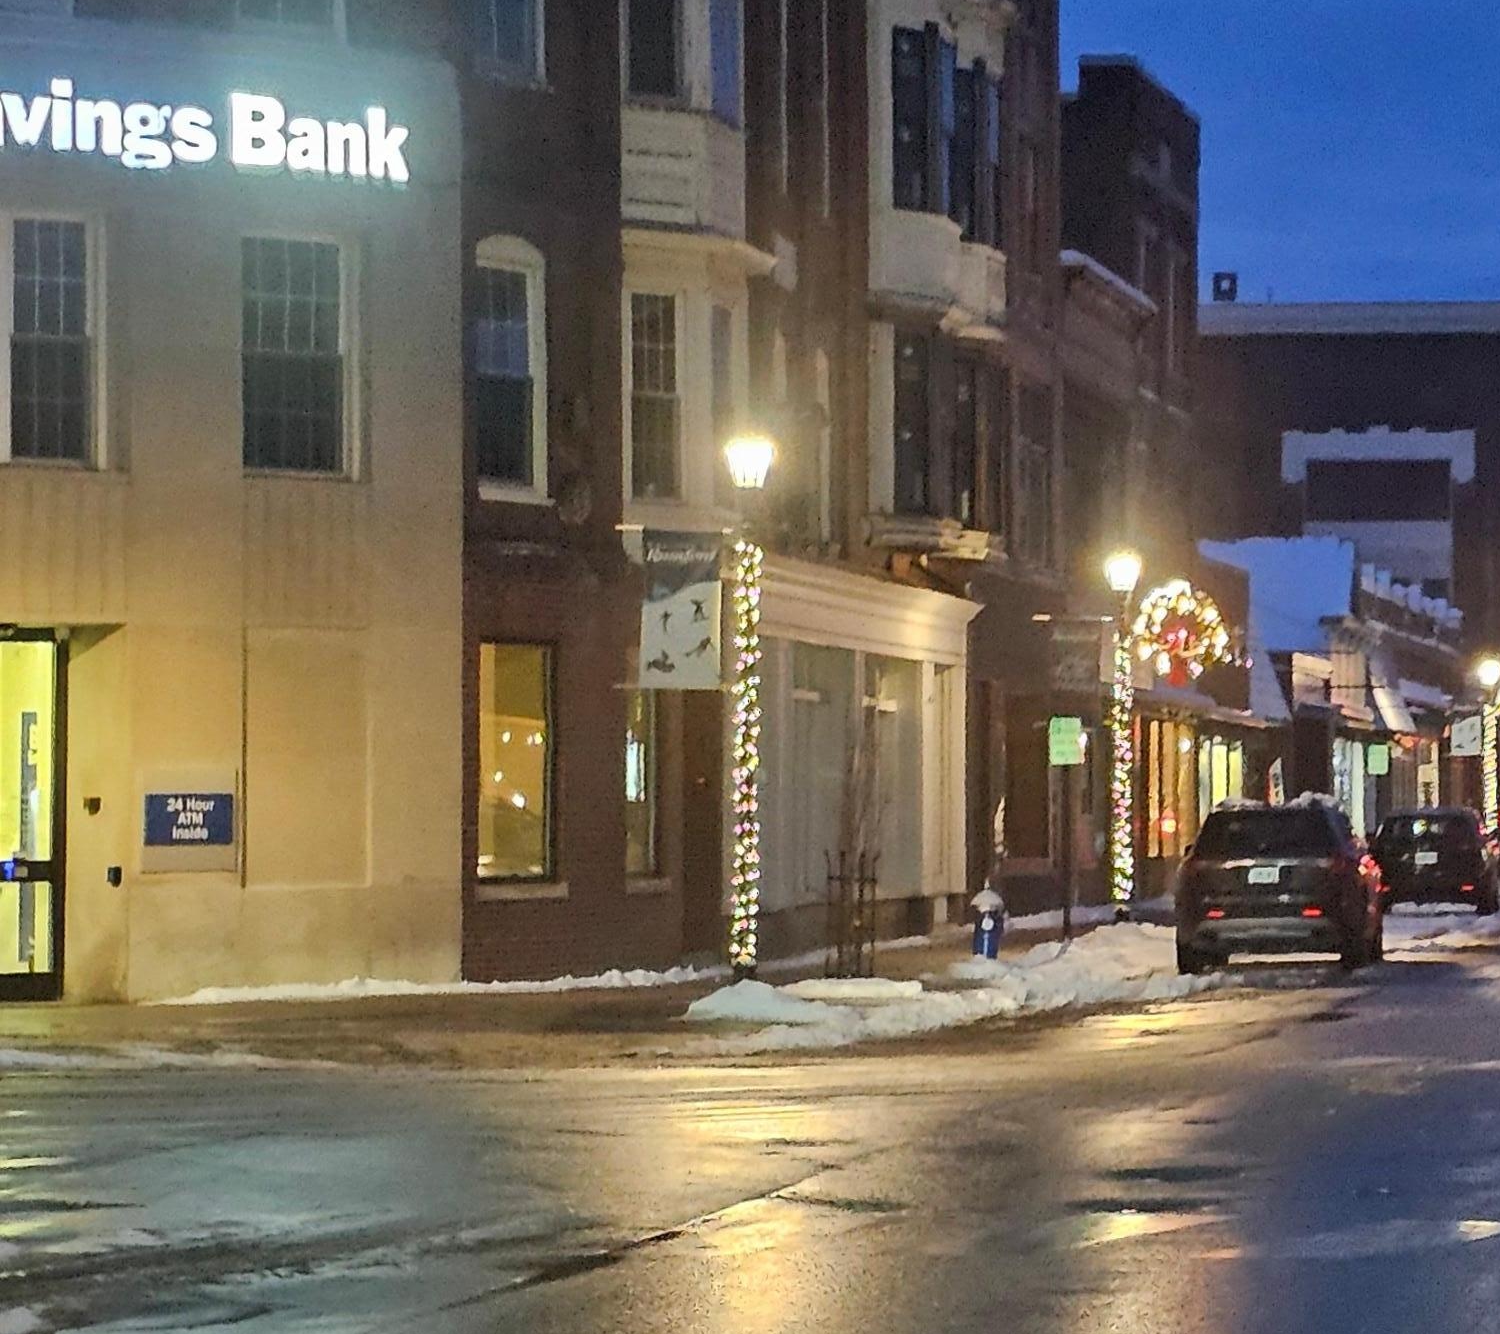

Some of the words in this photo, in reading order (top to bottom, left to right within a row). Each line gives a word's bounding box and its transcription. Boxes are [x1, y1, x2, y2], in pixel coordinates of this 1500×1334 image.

[0, 78, 217, 169] vings
[231, 92, 410, 183] Bank
[166, 797, 183, 812] 24
[186, 797, 215, 812] Hour
[177, 811, 204, 825] ATM
[172, 825, 209, 840] Inside
